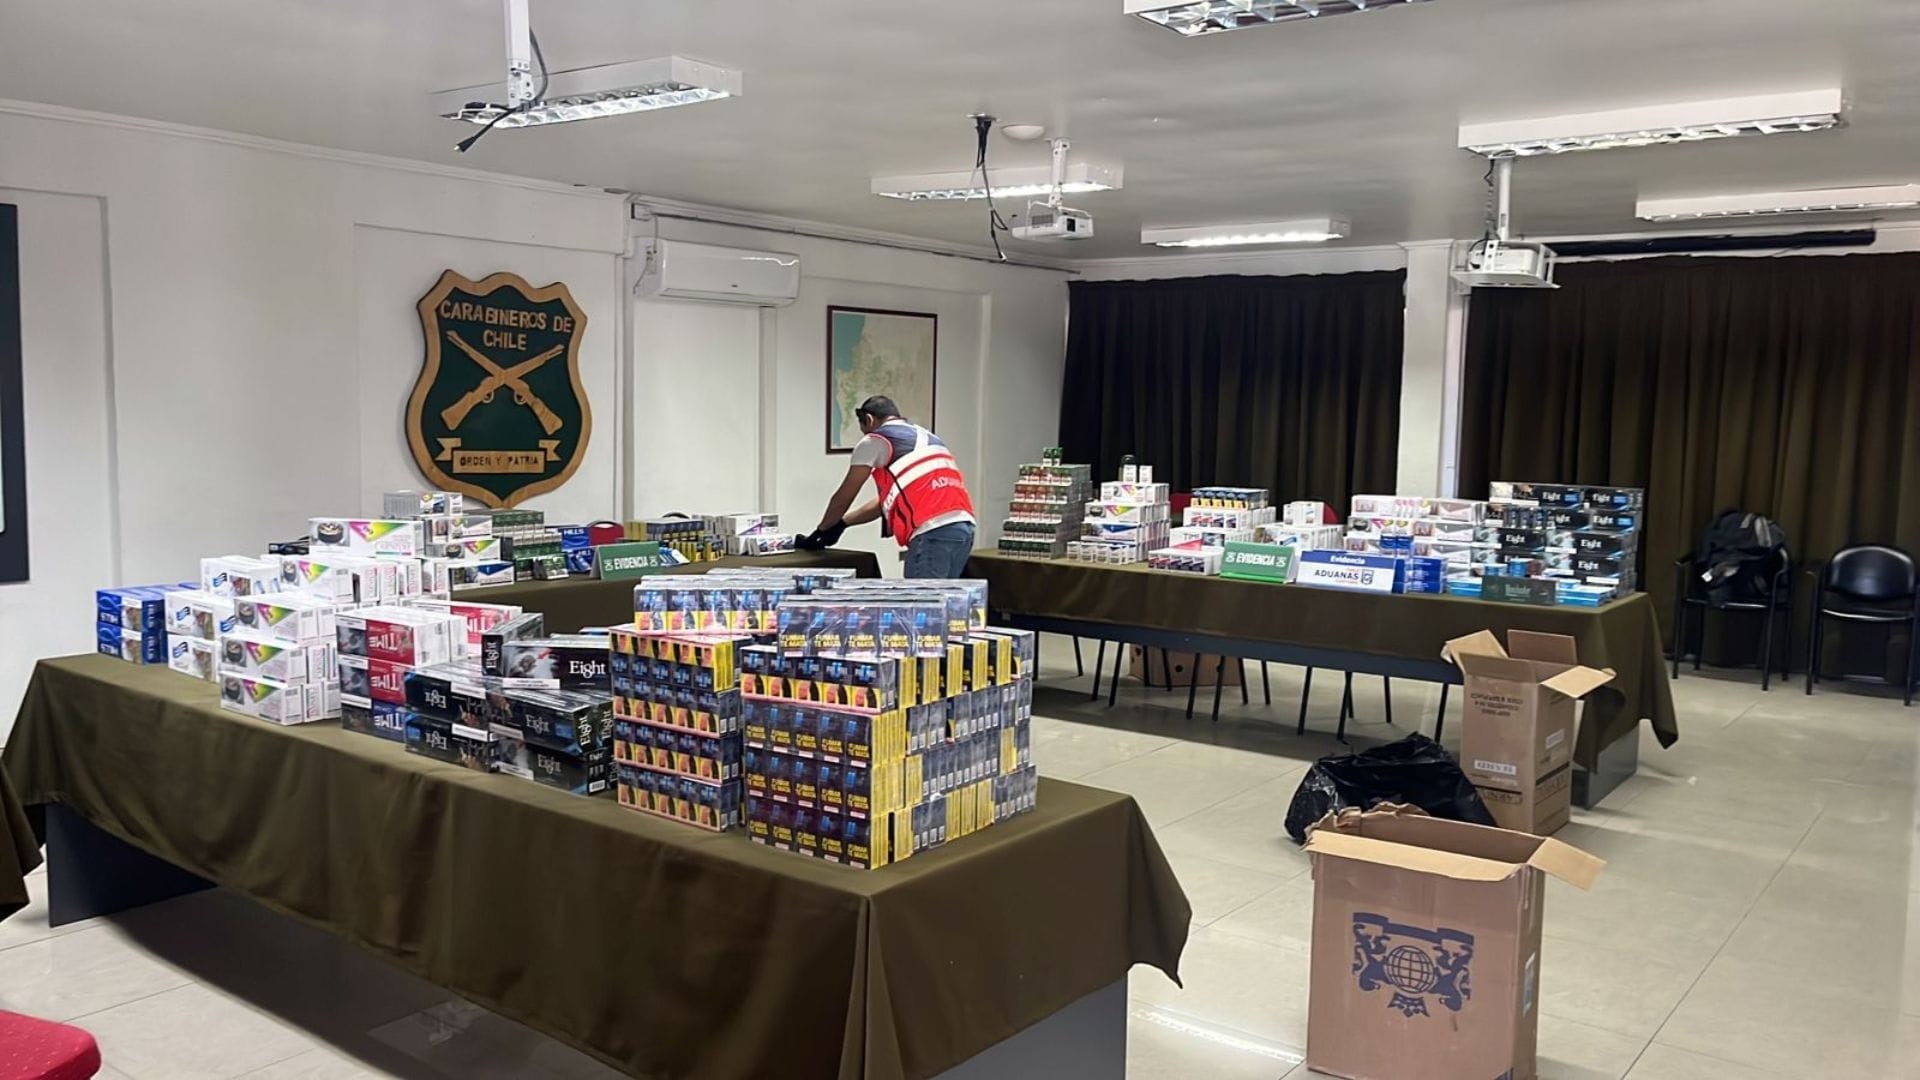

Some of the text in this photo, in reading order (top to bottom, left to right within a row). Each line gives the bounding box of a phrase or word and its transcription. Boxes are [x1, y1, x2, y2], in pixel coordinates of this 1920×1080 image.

[440, 300, 573, 333] CARABINEROS DE
[482, 330, 527, 350] CHILE
[459, 455, 538, 467] ORDEN Y PATRIA
[614, 556, 649, 570] EVIDENCIA
[1314, 568, 1360, 581] ADUANAS
[569, 660, 606, 679] Eight
[578, 714, 593, 746] Eight
